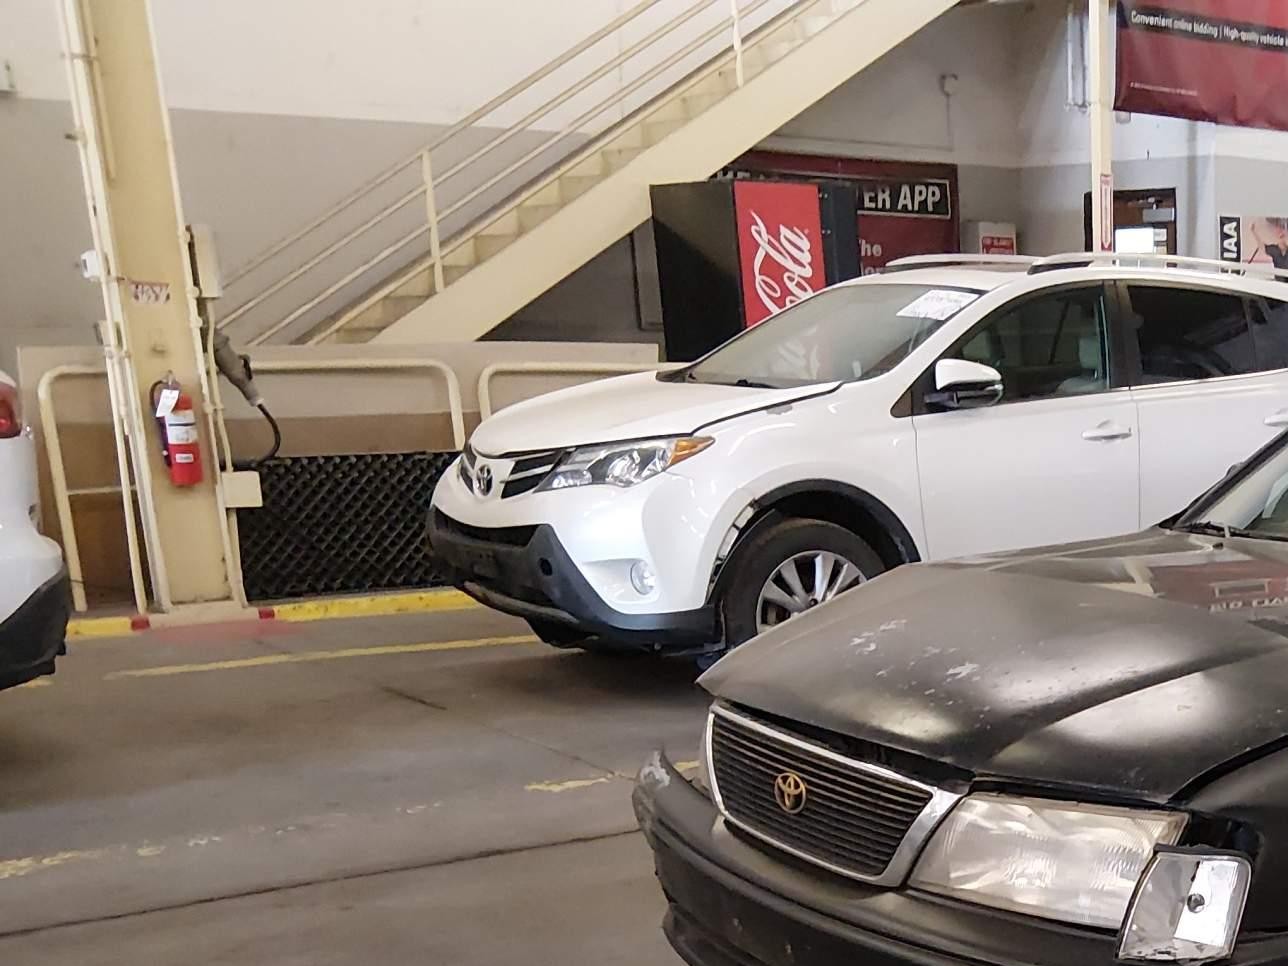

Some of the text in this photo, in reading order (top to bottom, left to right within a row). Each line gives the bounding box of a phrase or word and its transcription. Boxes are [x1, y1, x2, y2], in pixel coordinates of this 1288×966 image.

[1131, 10, 1172, 28] Convenient
[1194, 20, 1218, 38] bidding
[856, 184, 941, 212] ER APP
[859, 239, 882, 257] he
[1223, 221, 1238, 258] IAA
